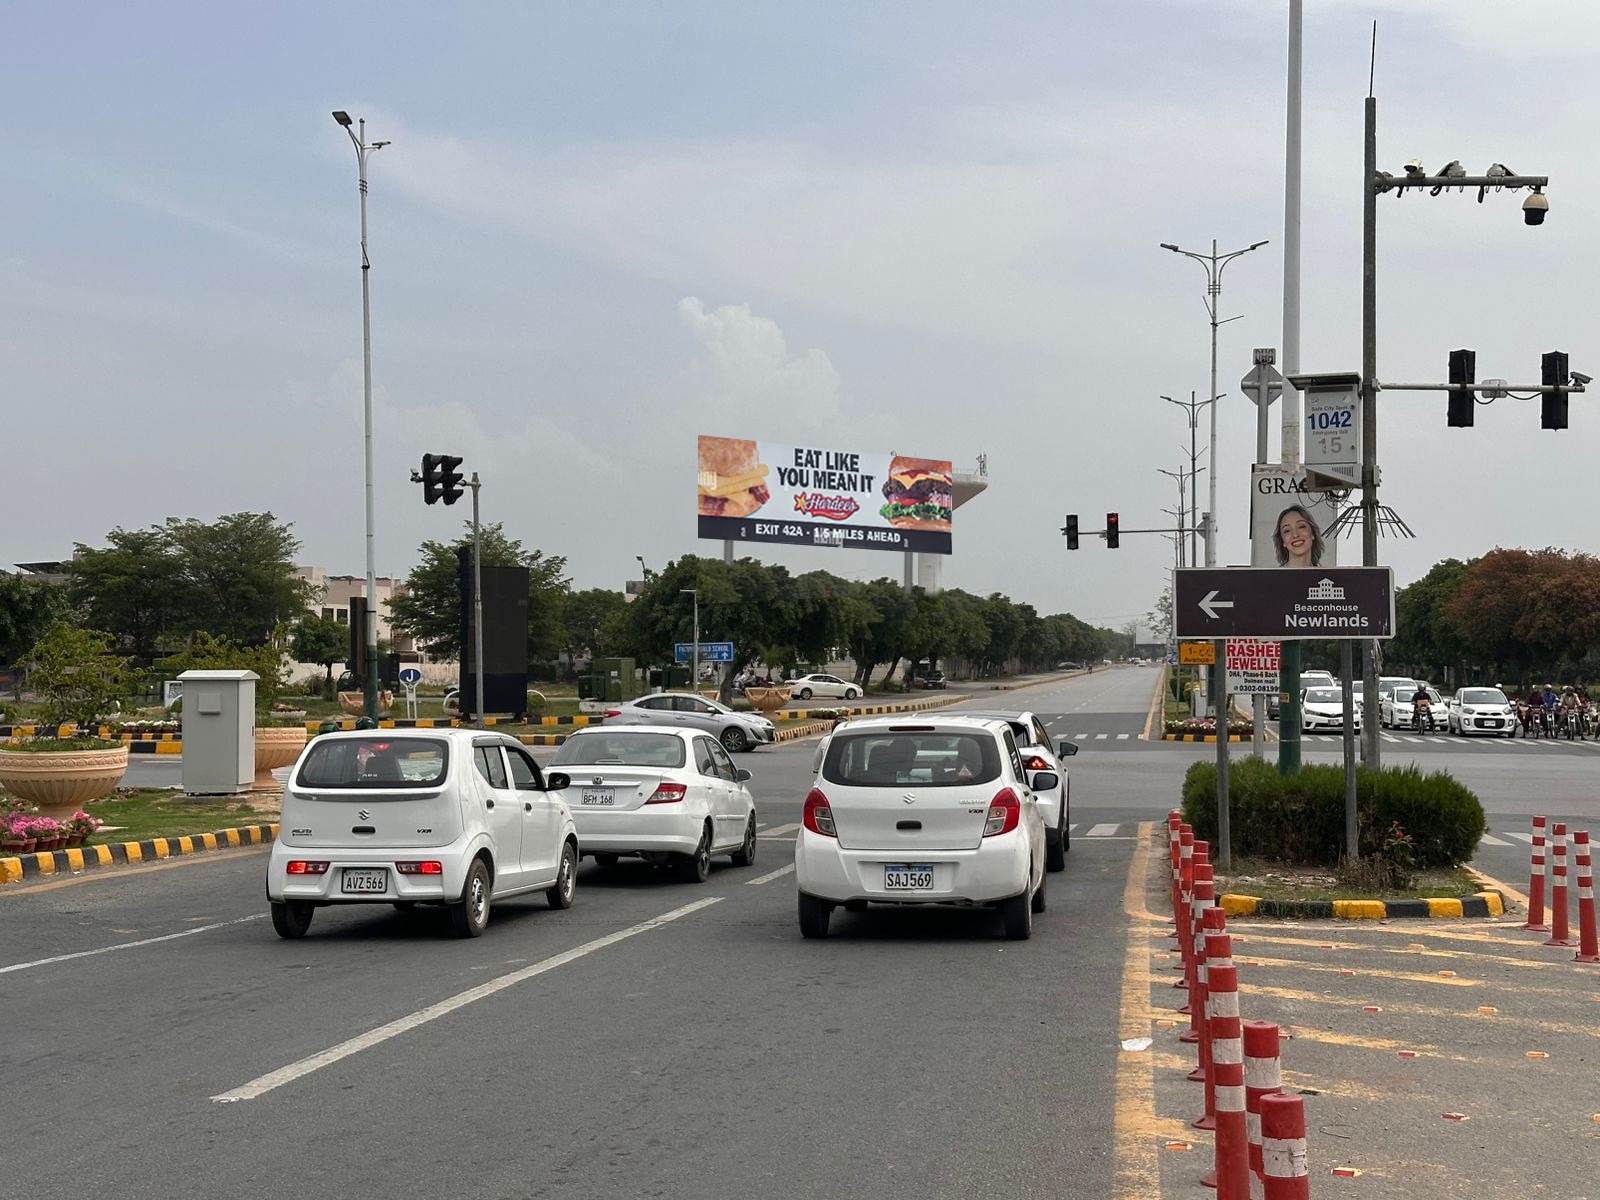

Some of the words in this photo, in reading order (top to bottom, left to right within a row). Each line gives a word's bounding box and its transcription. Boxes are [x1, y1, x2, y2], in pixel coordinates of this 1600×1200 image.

[1307, 410, 1352, 430] 1042
[1318, 437, 1342, 455] 15
[794, 448, 822, 468] EAT
[826, 451, 859, 473] LIKE
[777, 466, 809, 488] YOU
[813, 470, 857, 492] MEAN
[861, 474, 874, 493] IT
[755, 523, 780, 536] EXIT
[782, 525, 803, 537] 42A
[833, 528, 864, 540] MILES
[867, 531, 901, 543] AHEAD
[1294, 603, 1359, 612] Beaconhouse
[1285, 613, 1369, 628] Newlands
[1227, 657, 1280, 670] JEWELLE
[405, 669, 414, 682] J
[600, 795, 613, 804] 168
[346, 877, 365, 889] AVZ
[366, 877, 383, 889] 566
